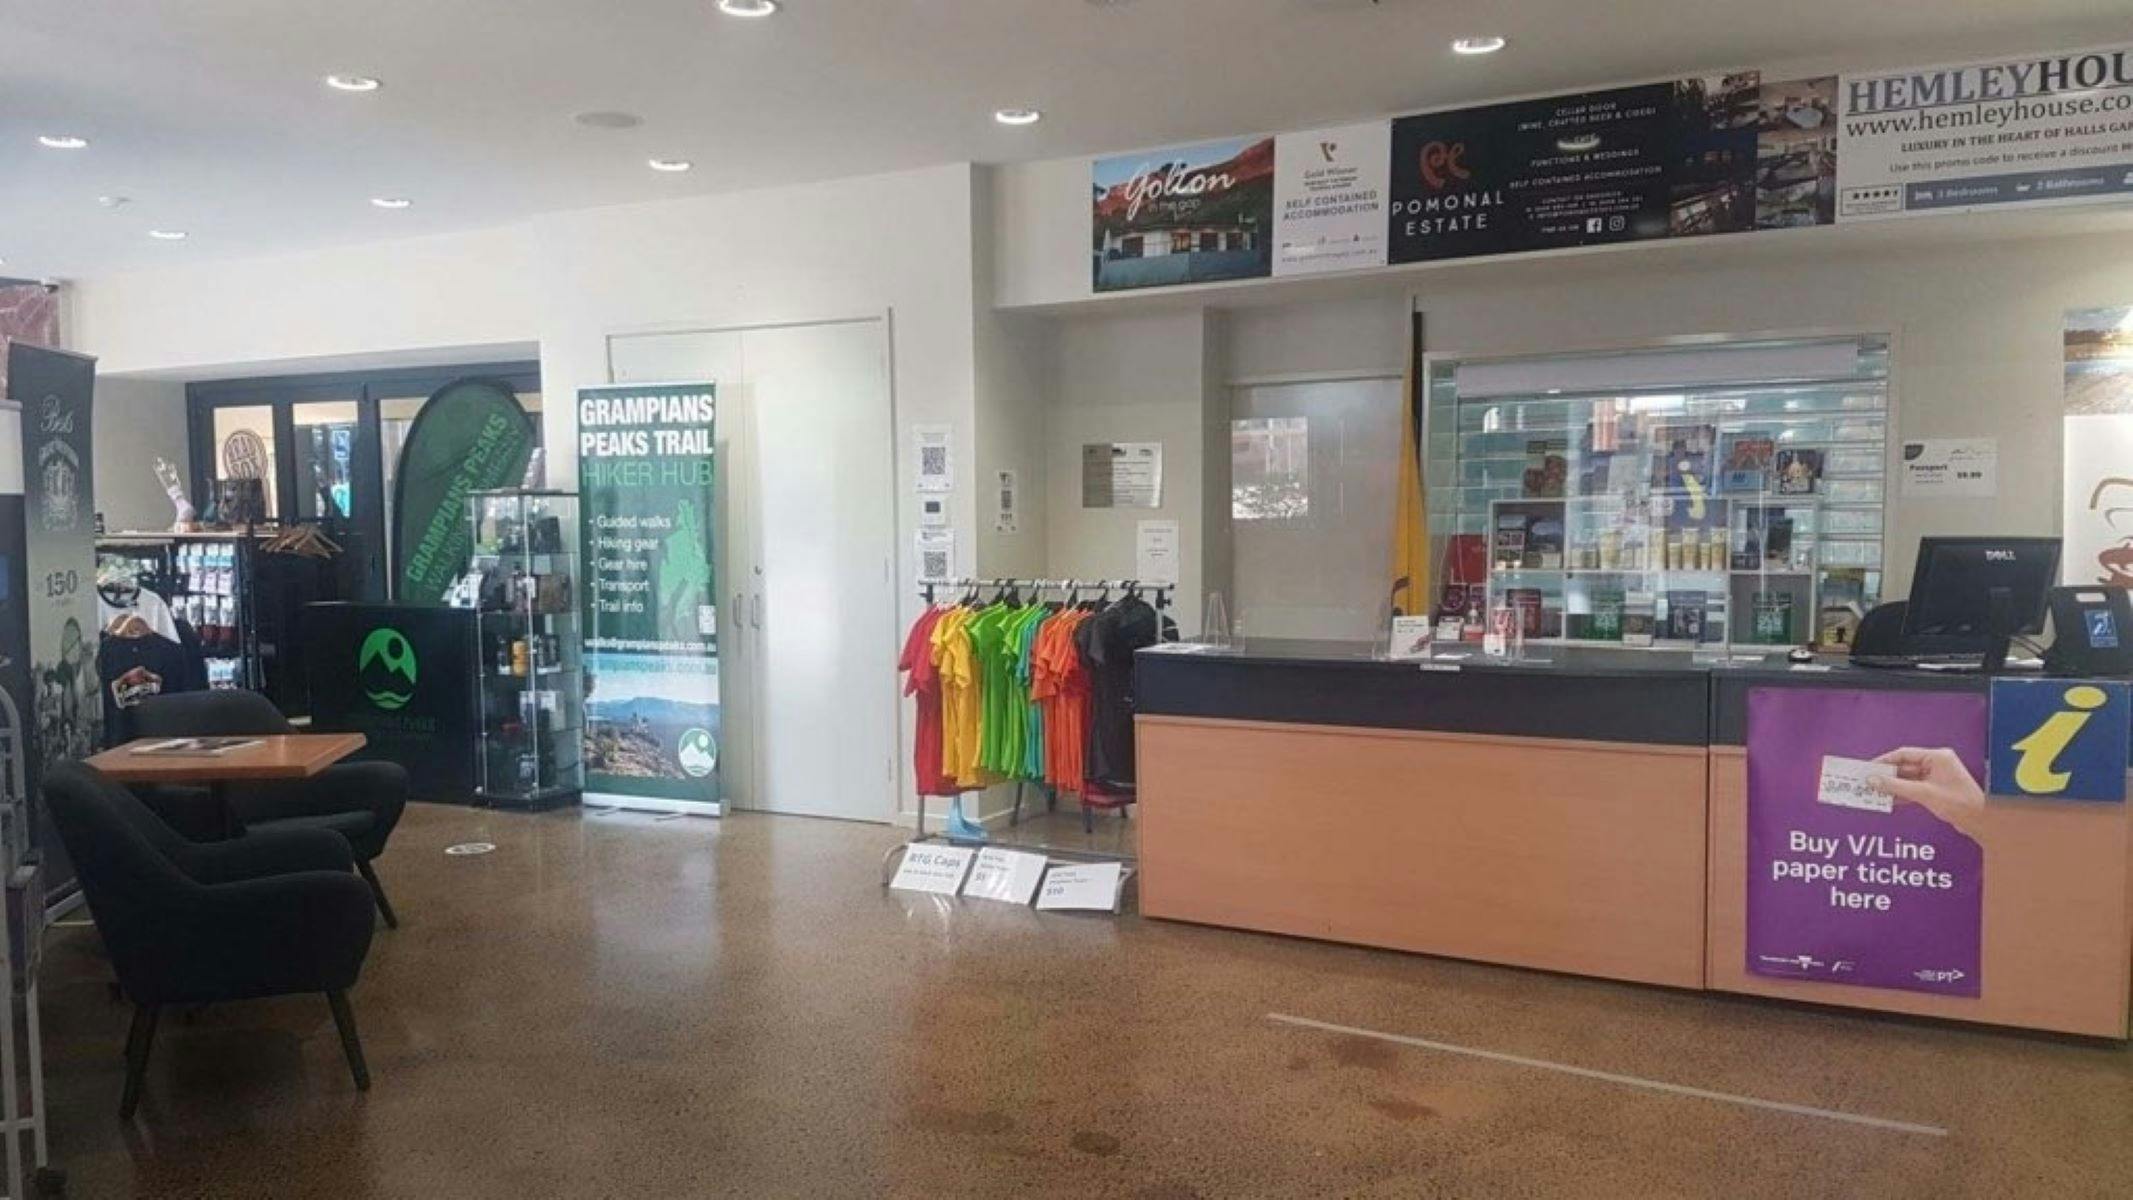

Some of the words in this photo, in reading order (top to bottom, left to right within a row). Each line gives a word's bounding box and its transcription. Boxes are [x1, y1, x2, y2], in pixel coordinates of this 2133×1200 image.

[1848, 53, 2133, 113] HEMLEYHOU
[1846, 94, 2132, 138] www.hemleyhouse.co
[1901, 139, 1948, 152] LUXURY
[1952, 138, 1966, 149] IN
[1970, 135, 1995, 147] THE
[1998, 130, 2040, 143] HEART
[2043, 128, 2062, 139] OF
[2064, 124, 2106, 137] HALLS
[1890, 161, 1909, 173] Use
[1911, 159, 1931, 171] this
[1934, 158, 1970, 170] promo
[1973, 154, 1999, 166] code
[2002, 152, 2014, 163] to
[2017, 149, 2057, 161] receive
[2069, 144, 2119, 156] discount
[1283, 202, 1379, 220] ACCOMMODATION
[1286, 197, 1311, 209] SELF
[1314, 189, 1377, 206] CONTAINED
[1392, 190, 1504, 217] POMONAL
[1405, 213, 1488, 236] ESTATE
[580, 395, 714, 425] GRAMPIANS
[580, 430, 649, 457] PEAKS
[653, 428, 714, 456] TRAIL
[582, 462, 652, 487] HIKER
[661, 461, 714, 486] HUB
[597, 514, 637, 528] Guided
[640, 515, 671, 528] walks
[599, 537, 631, 552] Hiking
[634, 538, 659, 552] gear
[599, 557, 623, 571] Gear
[625, 558, 648, 571] hire
[46, 569, 78, 598] 150
[599, 578, 650, 594] Transport
[599, 599, 621, 613] Trail
[622, 600, 644, 613] info
[1789, 830, 1839, 858] Buy
[1848, 835, 1936, 861] V/Line
[1772, 858, 1848, 883] paper
[1857, 861, 1953, 889] tickets
[1830, 886, 1892, 911] here
